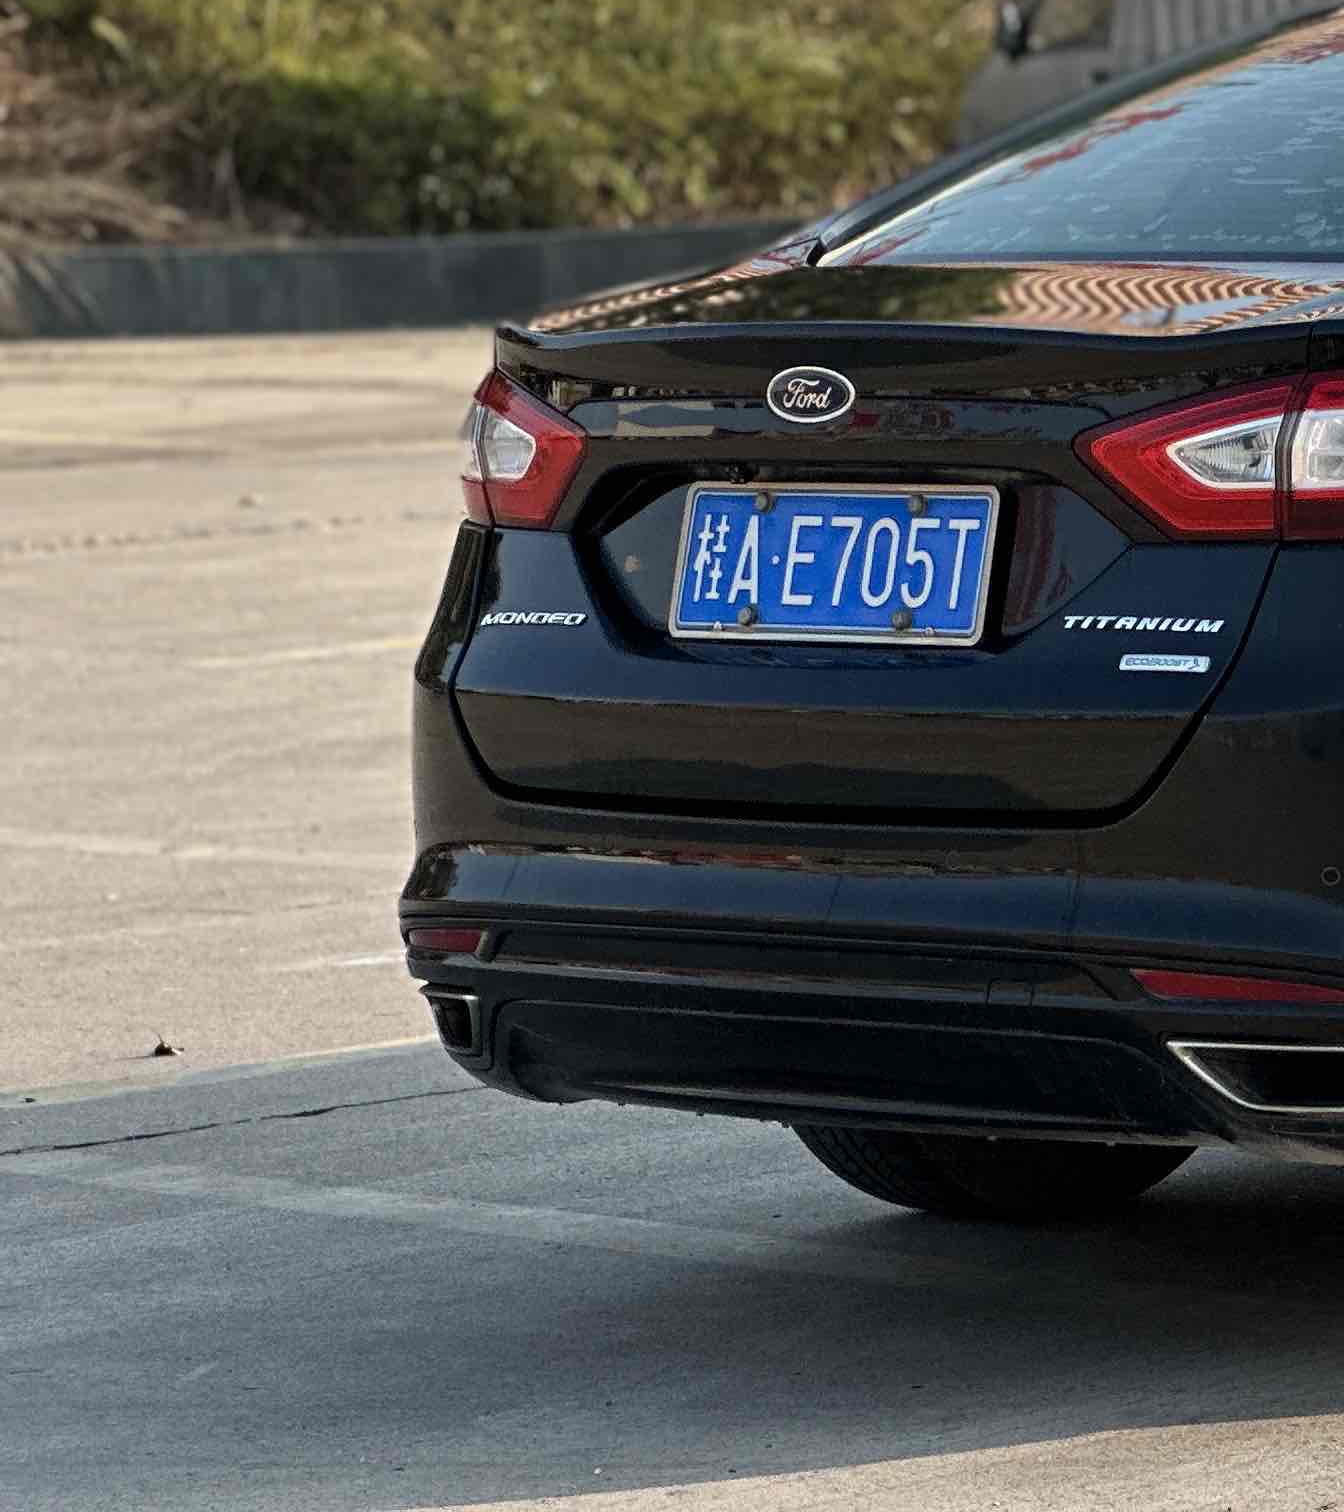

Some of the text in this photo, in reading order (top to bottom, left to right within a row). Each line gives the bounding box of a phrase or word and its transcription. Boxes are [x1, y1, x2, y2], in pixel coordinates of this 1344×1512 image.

[783, 378, 832, 409] Ford
[481, 611, 586, 626] MONDEO
[1064, 615, 1225, 633] TITANIUM
